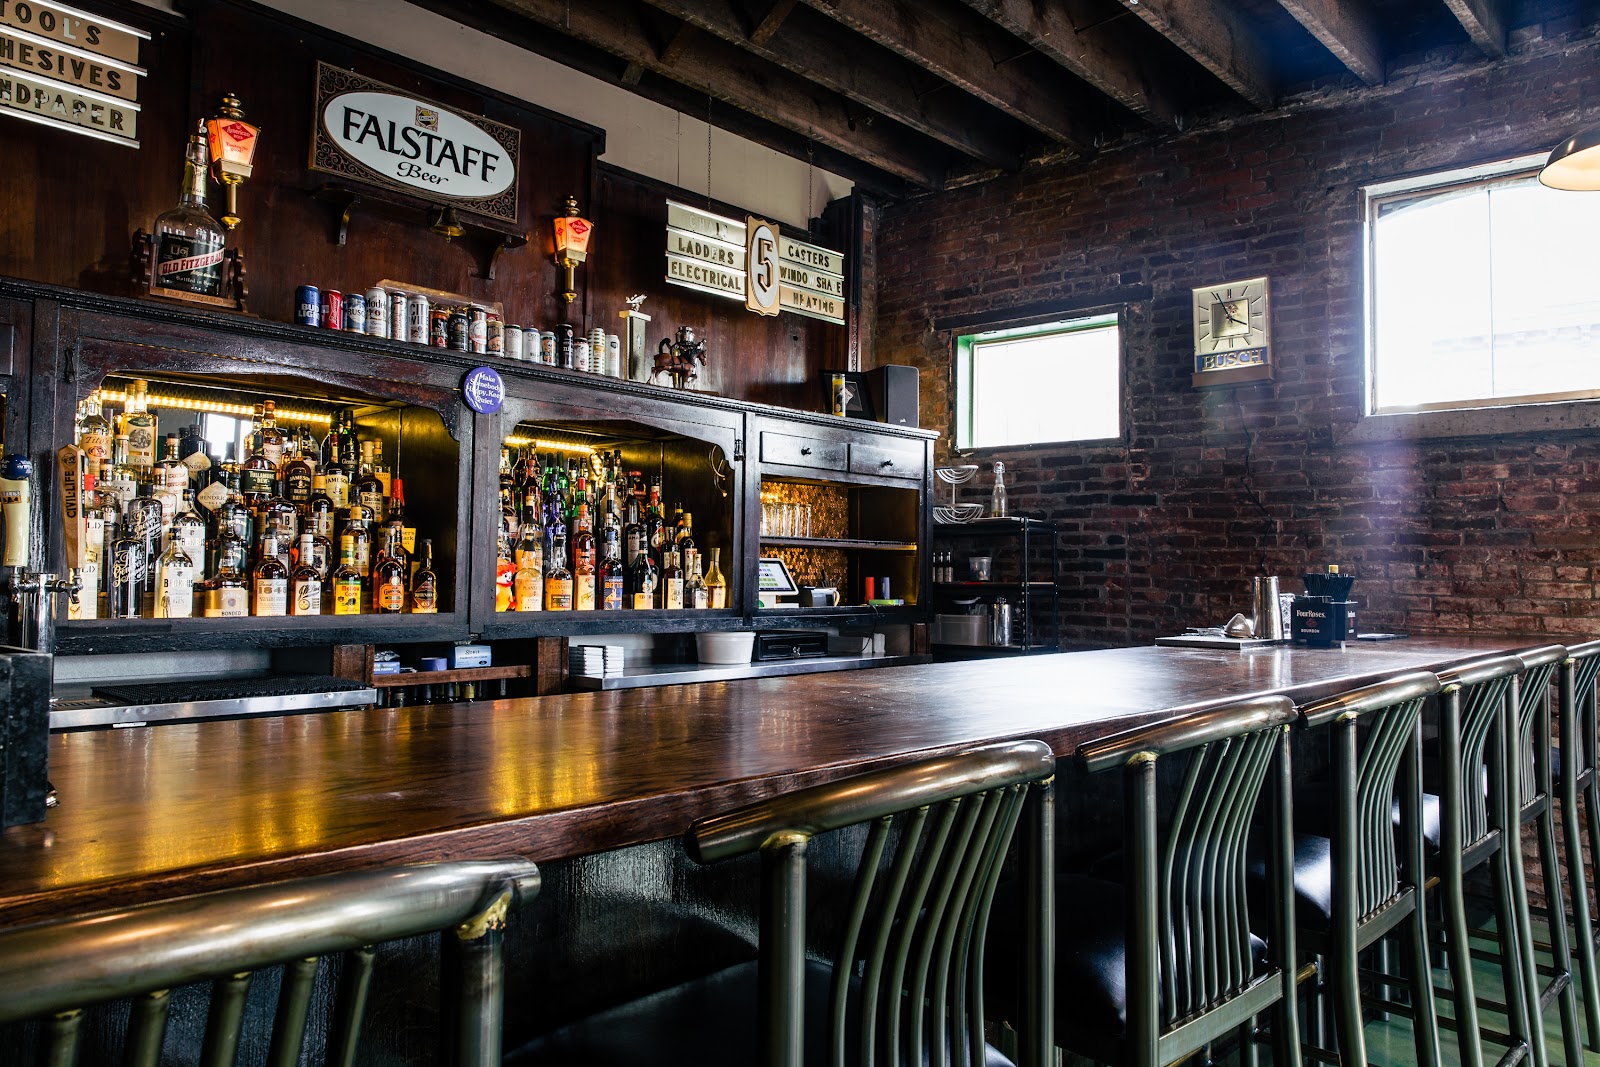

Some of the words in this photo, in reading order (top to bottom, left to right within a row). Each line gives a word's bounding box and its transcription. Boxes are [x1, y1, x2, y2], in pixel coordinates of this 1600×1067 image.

[0, 37, 121, 91] HESIVES
[343, 106, 500, 182] FALSTAFF
[396, 161, 449, 185] Beer
[679, 238, 735, 265] LADDERS
[788, 245, 830, 267] CASTERS
[162, 261, 179, 274] OLD
[671, 261, 741, 290] ELECTRICAL
[757, 238, 774, 293] 5
[301, 303, 319, 312] BUD
[793, 292, 835, 314] HEATING
[1202, 349, 1263, 370] BUSCH
[479, 372, 496, 383] Make
